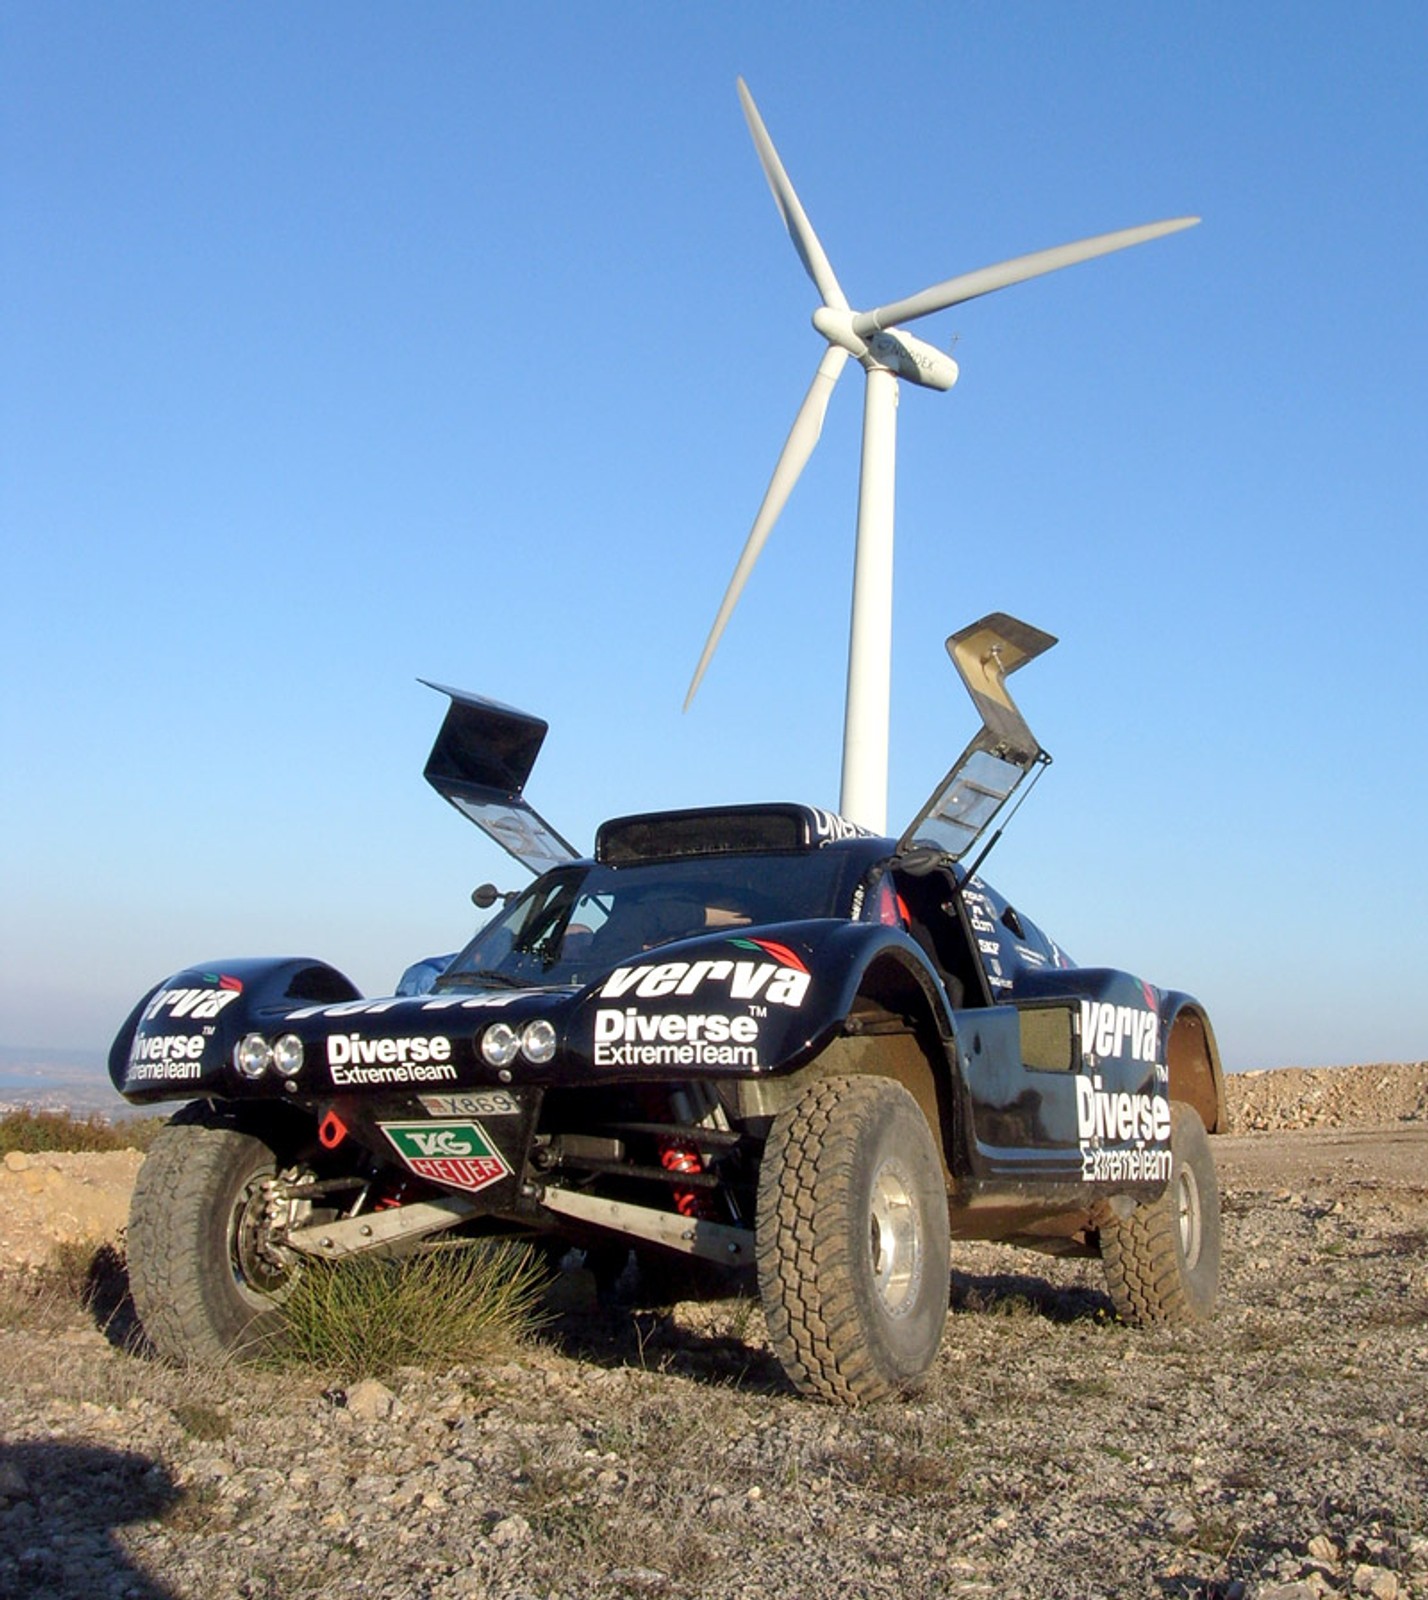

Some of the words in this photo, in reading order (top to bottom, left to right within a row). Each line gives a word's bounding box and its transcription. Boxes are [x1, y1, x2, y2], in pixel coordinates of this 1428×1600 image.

[600, 959, 812, 1008] verva
[142, 988, 241, 1021] rva
[594, 1006, 759, 1043] Diverse
[1080, 1000, 1160, 1062] verva
[130, 1031, 205, 1061] iverse
[327, 1033, 452, 1065] Diverse
[594, 1040, 758, 1067] ExtremeTeam
[126, 1057, 201, 1081] tremeTeam
[330, 1061, 459, 1086] ExtremeTeam
[442, 1094, 513, 1114] X869
[1075, 1074, 1172, 1141] Diverse
[405, 1130, 472, 1156] TAG
[415, 1159, 500, 1186] HEUER
[1079, 1140, 1173, 1182] ExtremeTeam
